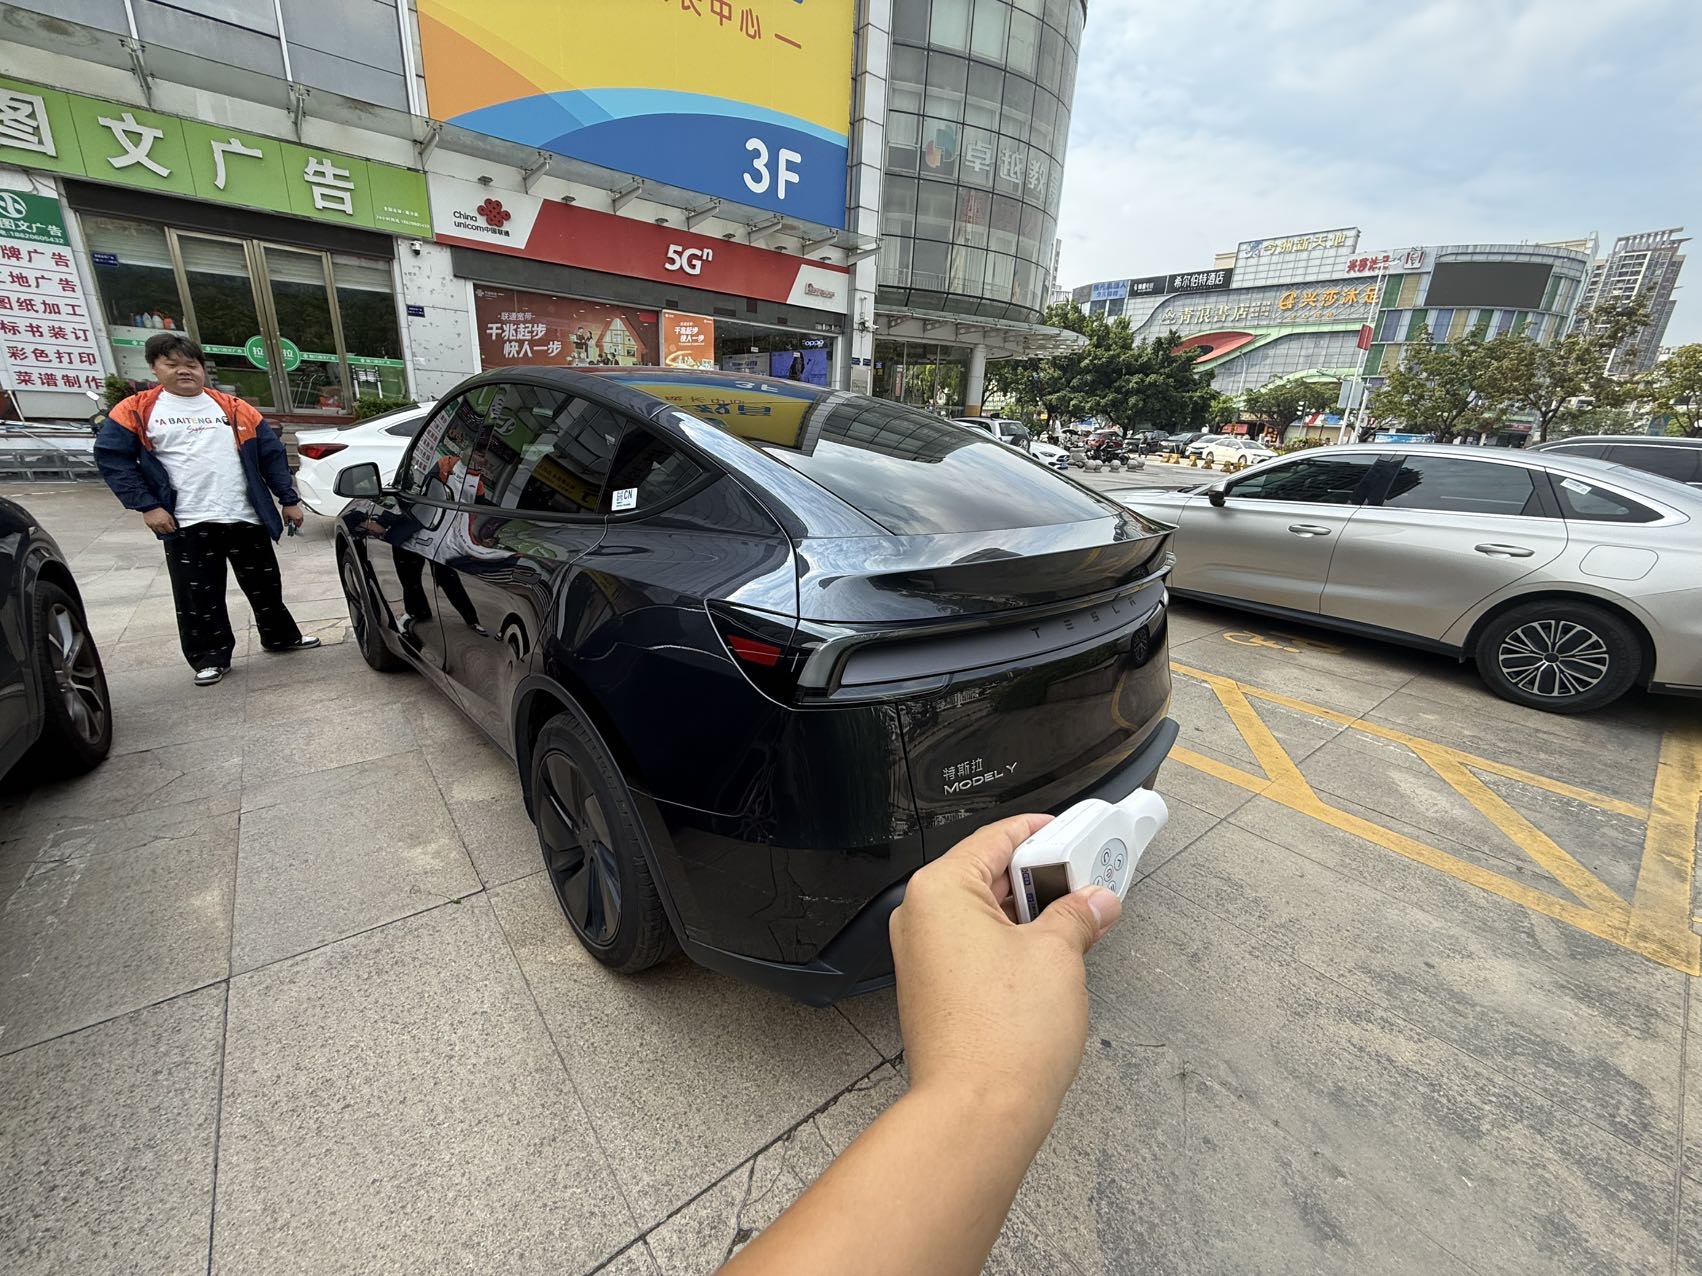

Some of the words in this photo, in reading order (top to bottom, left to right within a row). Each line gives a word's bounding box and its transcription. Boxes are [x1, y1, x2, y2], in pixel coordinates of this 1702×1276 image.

[0, 88, 355, 216] 图文广告
[743, 137, 802, 200] 3F
[453, 211, 478, 222] China
[0, 217, 63, 237] 图文广告
[454, 221, 485, 233] unicom
[1174, 271, 1226, 289] 希尔伯特酒店
[0, 295, 86, 317] 图纸加工
[0, 319, 90, 342] 标书装订
[487, 323, 547, 340] 千兆起步
[6, 346, 97, 366] 彩色打印
[504, 341, 562, 358] 快人一步
[14, 370, 105, 389] 菜谱制作
[943, 758, 984, 781] 特斯拉
[944, 770, 1004, 796] MODEL
[1006, 762, 1018, 775] Y
